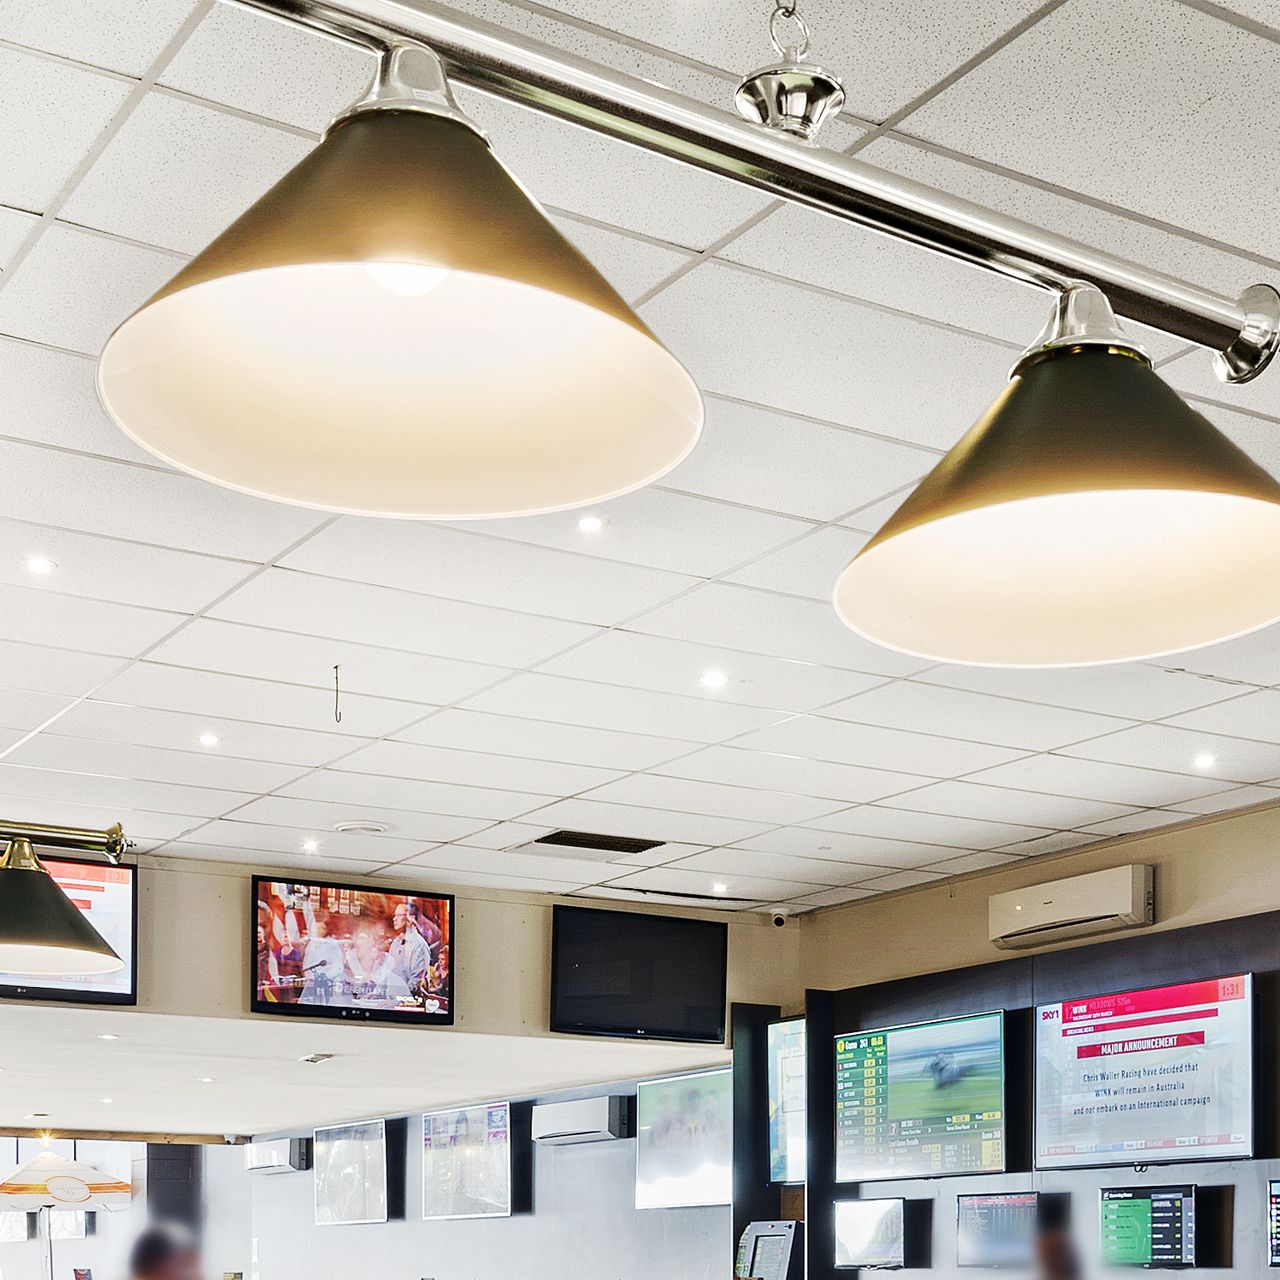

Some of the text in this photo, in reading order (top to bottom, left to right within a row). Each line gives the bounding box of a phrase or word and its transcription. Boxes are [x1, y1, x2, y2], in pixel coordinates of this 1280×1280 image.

[1042, 1010, 1059, 1020] SKY1
[1101, 1036, 1178, 1055] MAJOR ANNOUNCEMENT
[1083, 1063, 1198, 1082] Chris Waller Racing have decided that
[1113, 1086, 1125, 1096] will
[1126, 1084, 1147, 1095] remain
[1147, 1084, 1155, 1093] in
[1156, 1081, 1185, 1092] Australia
[1073, 1106, 1085, 1116] and
[1085, 1106, 1095, 1114] not
[1096, 1103, 1118, 1113] embark
[1120, 1103, 1128, 1111] on
[1137, 1097, 1179, 1110] International
[1180, 1096, 1211, 1107] campaign
